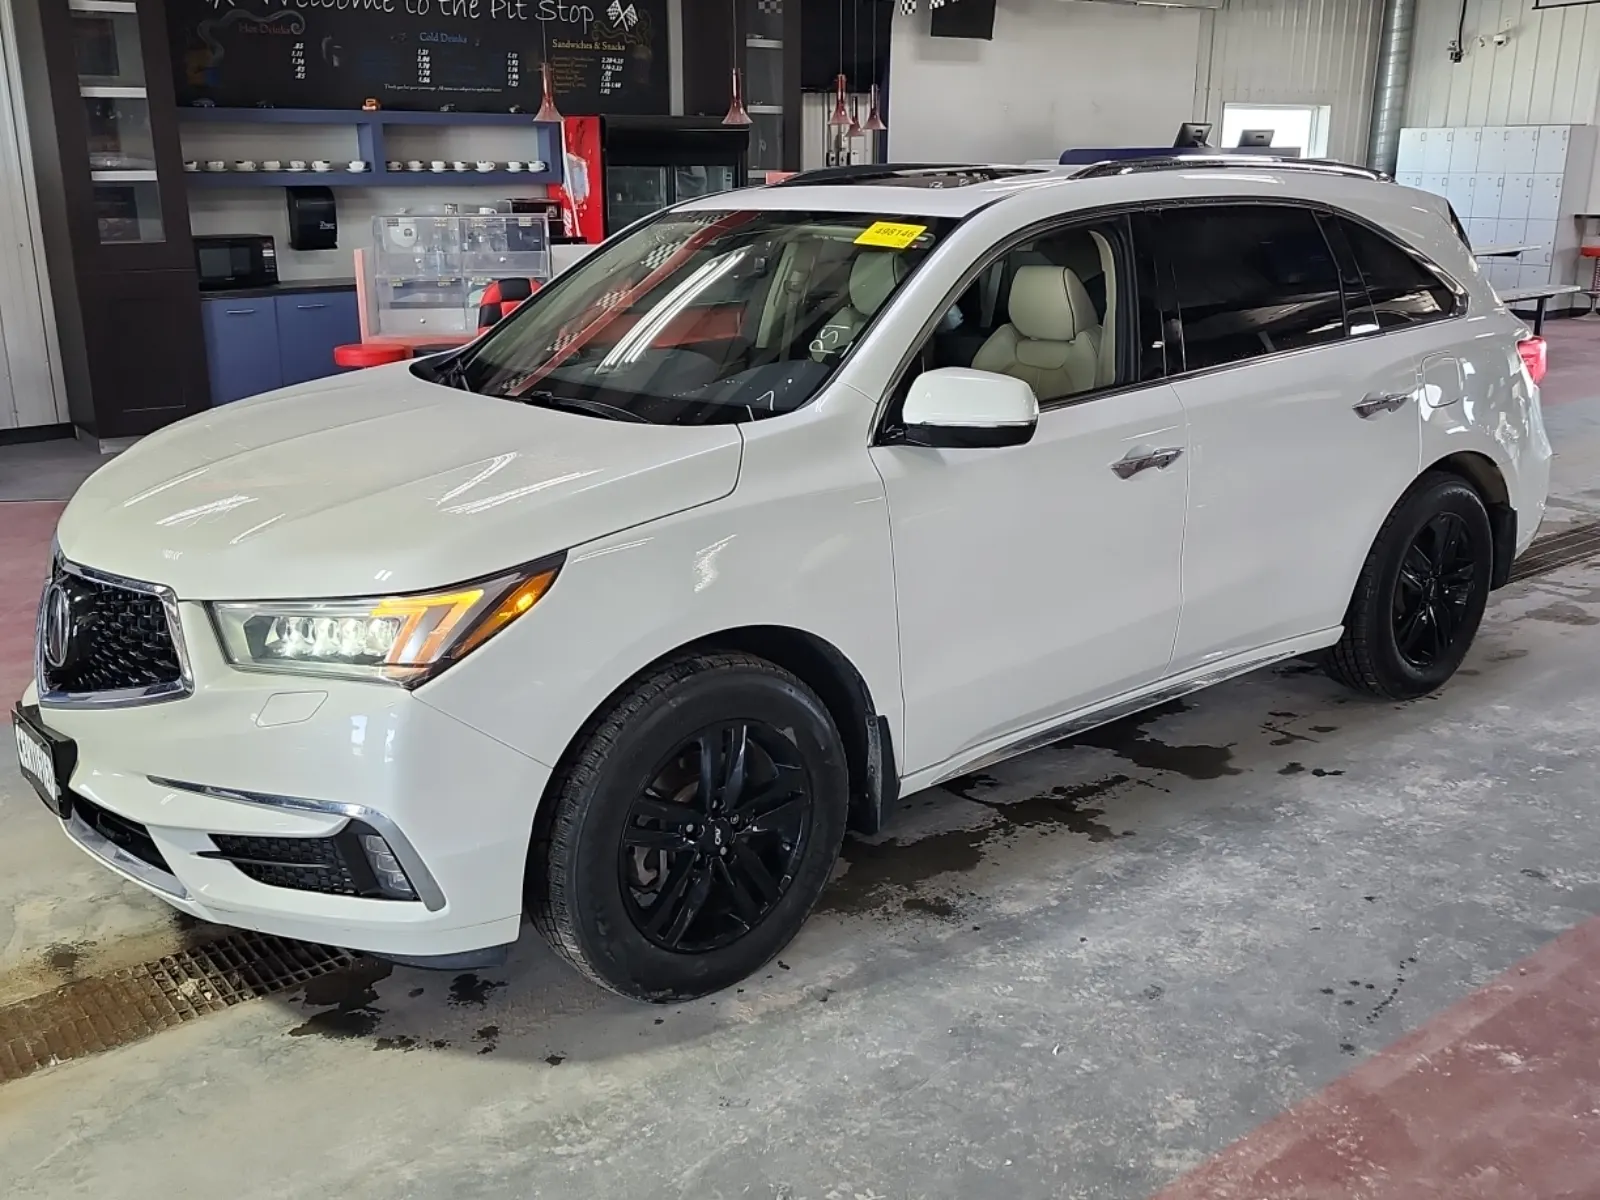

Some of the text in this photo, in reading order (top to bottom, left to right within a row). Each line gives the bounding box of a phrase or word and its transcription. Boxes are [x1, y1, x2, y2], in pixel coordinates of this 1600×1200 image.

[405, 0, 429, 16] to
[440, 0, 480, 18] the
[491, 0, 528, 20] Pit
[535, 0, 594, 34] Stop
[419, 31, 468, 44] Cold Drinks
[552, 38, 593, 50] Sandwiches
[602, 41, 626, 51] Snacks
